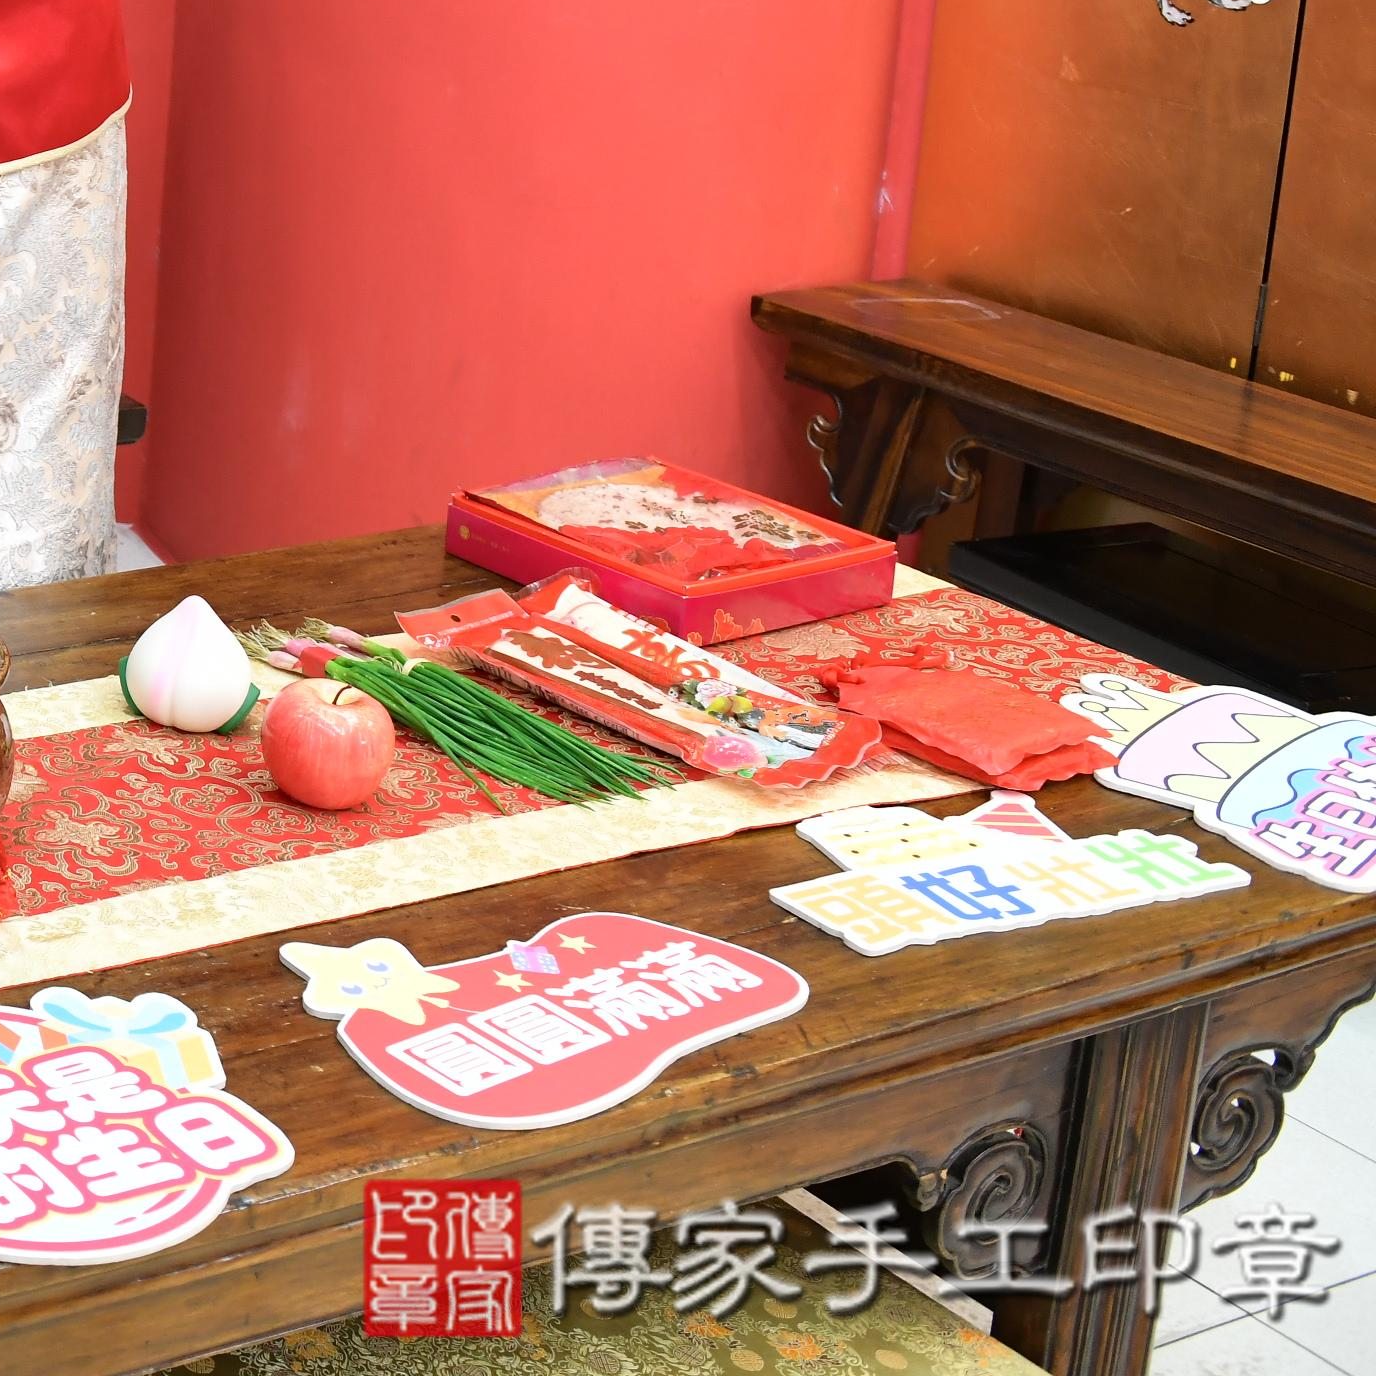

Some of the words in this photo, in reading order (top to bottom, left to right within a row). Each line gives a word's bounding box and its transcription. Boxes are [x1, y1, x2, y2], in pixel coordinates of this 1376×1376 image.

[798, 835, 1235, 943] 頭好壯壯
[385, 940, 766, 1097] 圓圓滿滿
